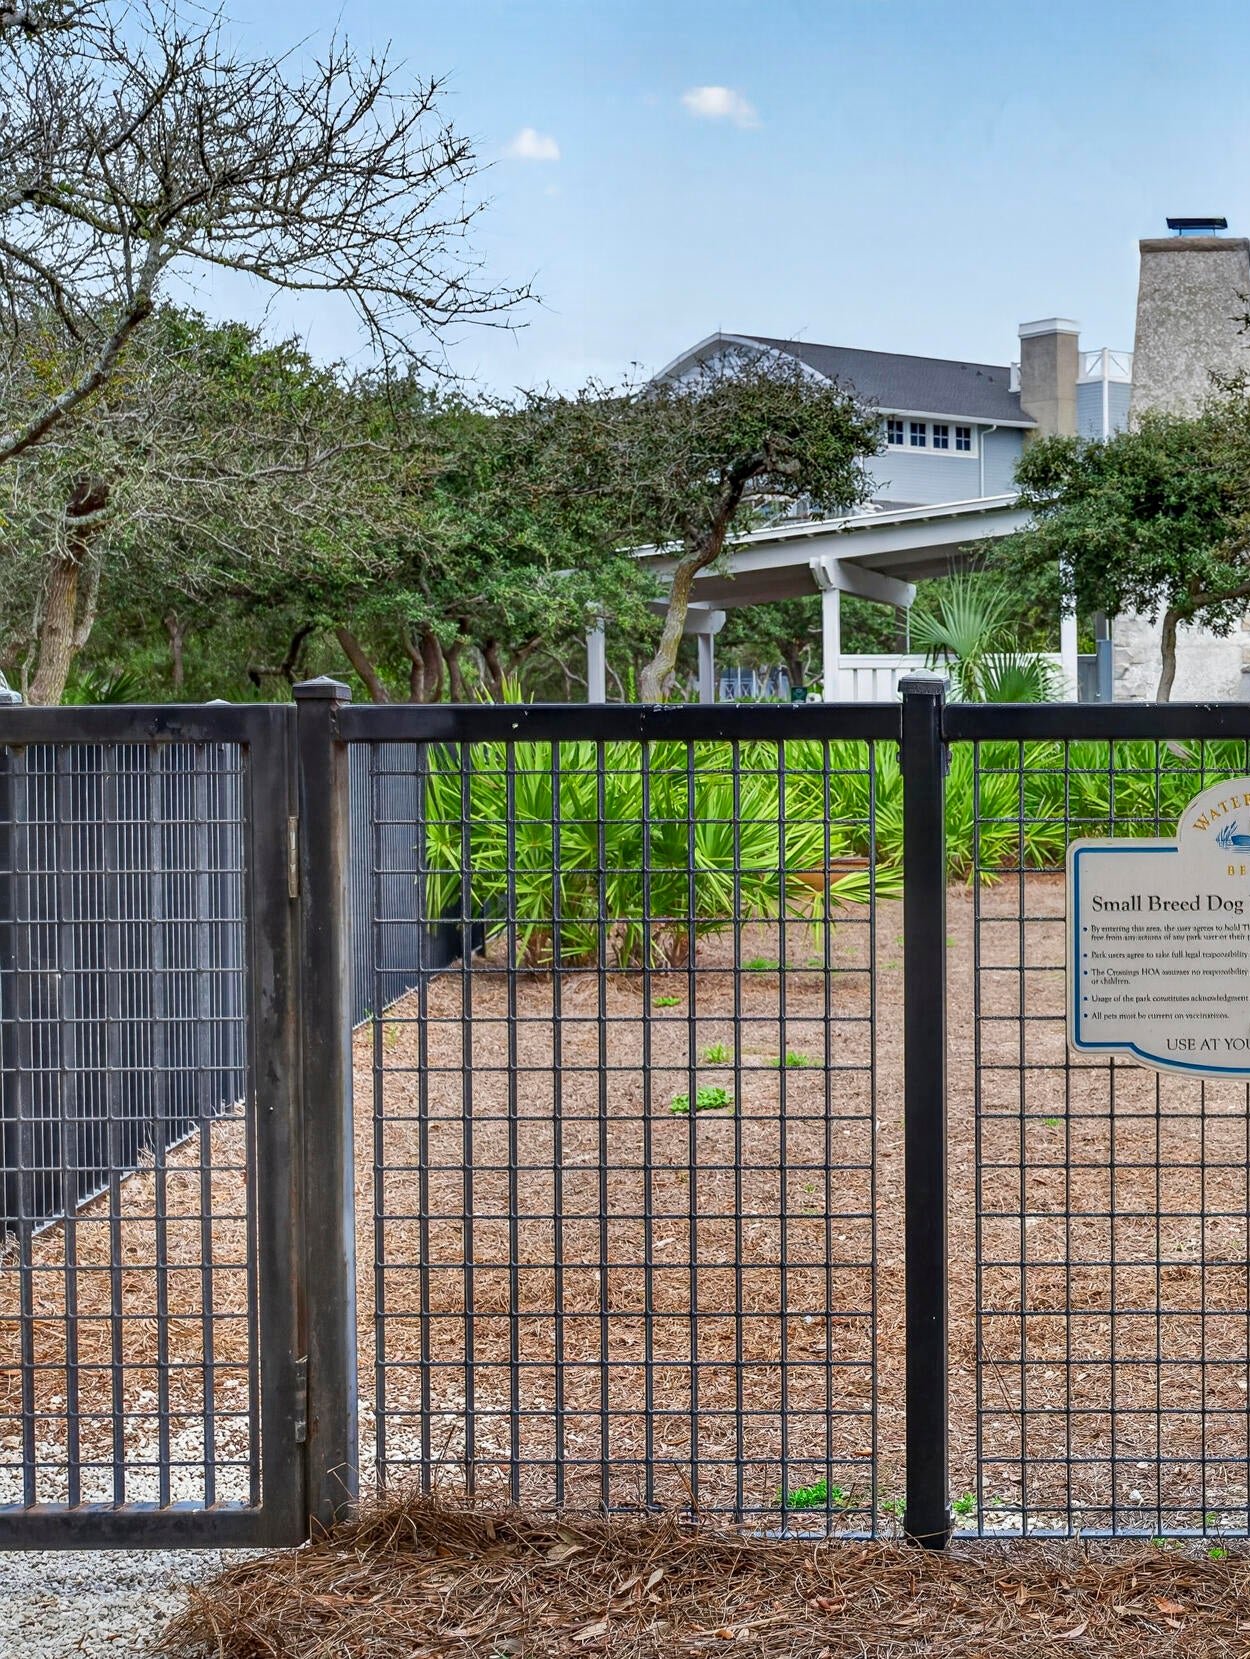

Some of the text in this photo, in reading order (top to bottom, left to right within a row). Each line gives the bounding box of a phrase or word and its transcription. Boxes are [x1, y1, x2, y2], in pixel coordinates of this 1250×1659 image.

[1092, 894, 1142, 912] Small
[1147, 894, 1200, 912] Breed
[1206, 894, 1244, 914] Dog
[1101, 924, 1130, 934] entering
[1131, 924, 1145, 932] this
[1193, 925, 1214, 933] agrees
[1224, 924, 1241, 932] hold
[1091, 933, 1104, 941] free
[1105, 933, 1121, 941] from
[1186, 933, 1202, 941] park
[1184, 951, 1201, 959] legal
[1202, 951, 1248, 959] responsibility
[1091, 968, 1105, 976] The
[1106, 968, 1140, 977] Crossings
[1141, 968, 1161, 976] HOA
[1202, 967, 1248, 976] responsibility
[1091, 994, 1112, 1003] Usage
[1135, 994, 1151, 1002] park
[1190, 994, 1248, 1002] acknowledgment
[1103, 1013, 1118, 1021] pets
[1166, 1038, 1196, 1051] USE
[1200, 1038, 1220, 1051] AT
